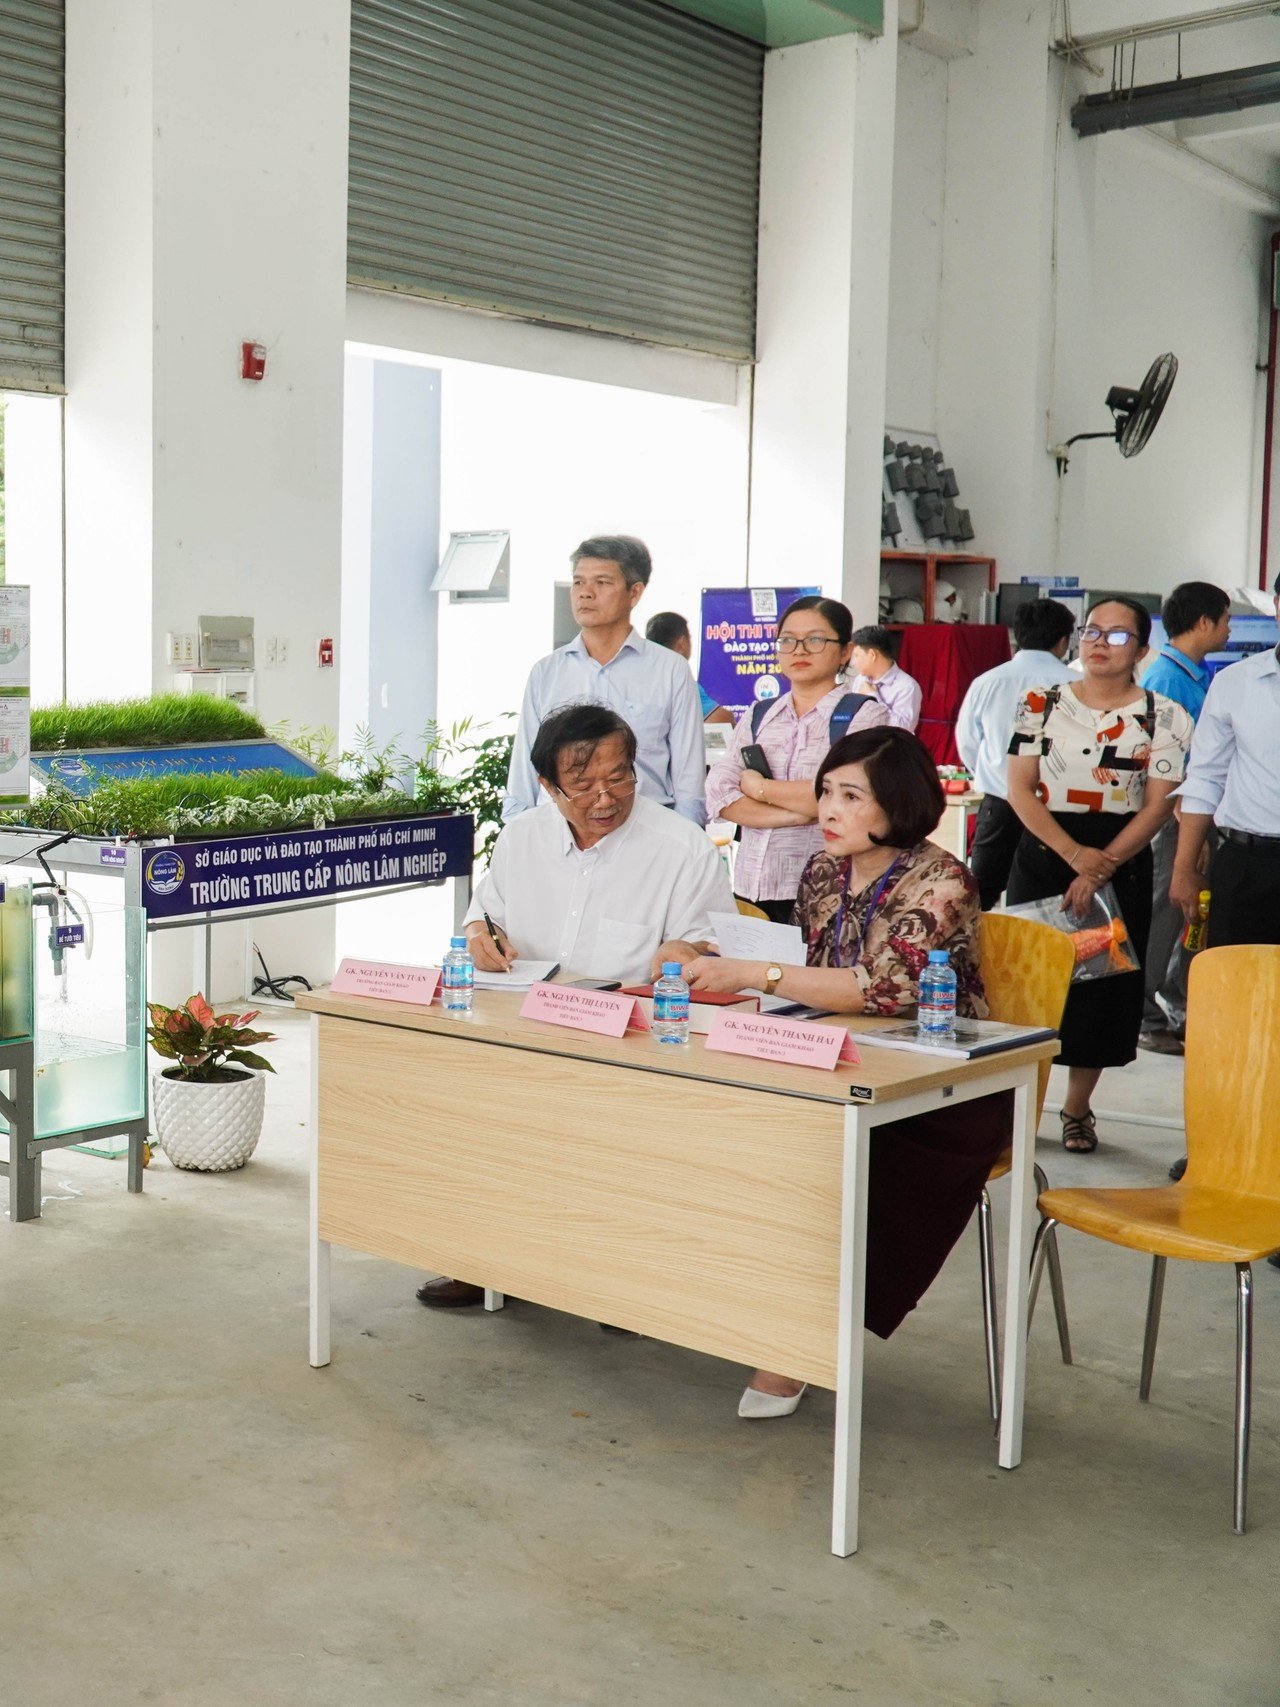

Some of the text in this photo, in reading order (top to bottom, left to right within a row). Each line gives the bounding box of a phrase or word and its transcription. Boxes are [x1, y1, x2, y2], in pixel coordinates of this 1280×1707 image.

[706, 621, 735, 642] HỘI
[737, 624, 762, 639] THI
[724, 641, 747, 653] ĐÀO
[749, 642, 770, 654] TẠO
[737, 662, 782, 674] NĂM 20
[196, 827, 436, 868] SỞ GIÁO DỤC VÀ ĐÀO TẠO THÀNH PHỐ HỒ CHÍ MINH
[190, 848, 447, 905] TRƯỜNG TRUNG CẤP NÔNG LÂM NGHIỆP
[537, 990, 549, 998] GK.
[724, 1020, 740, 1030] GK.
